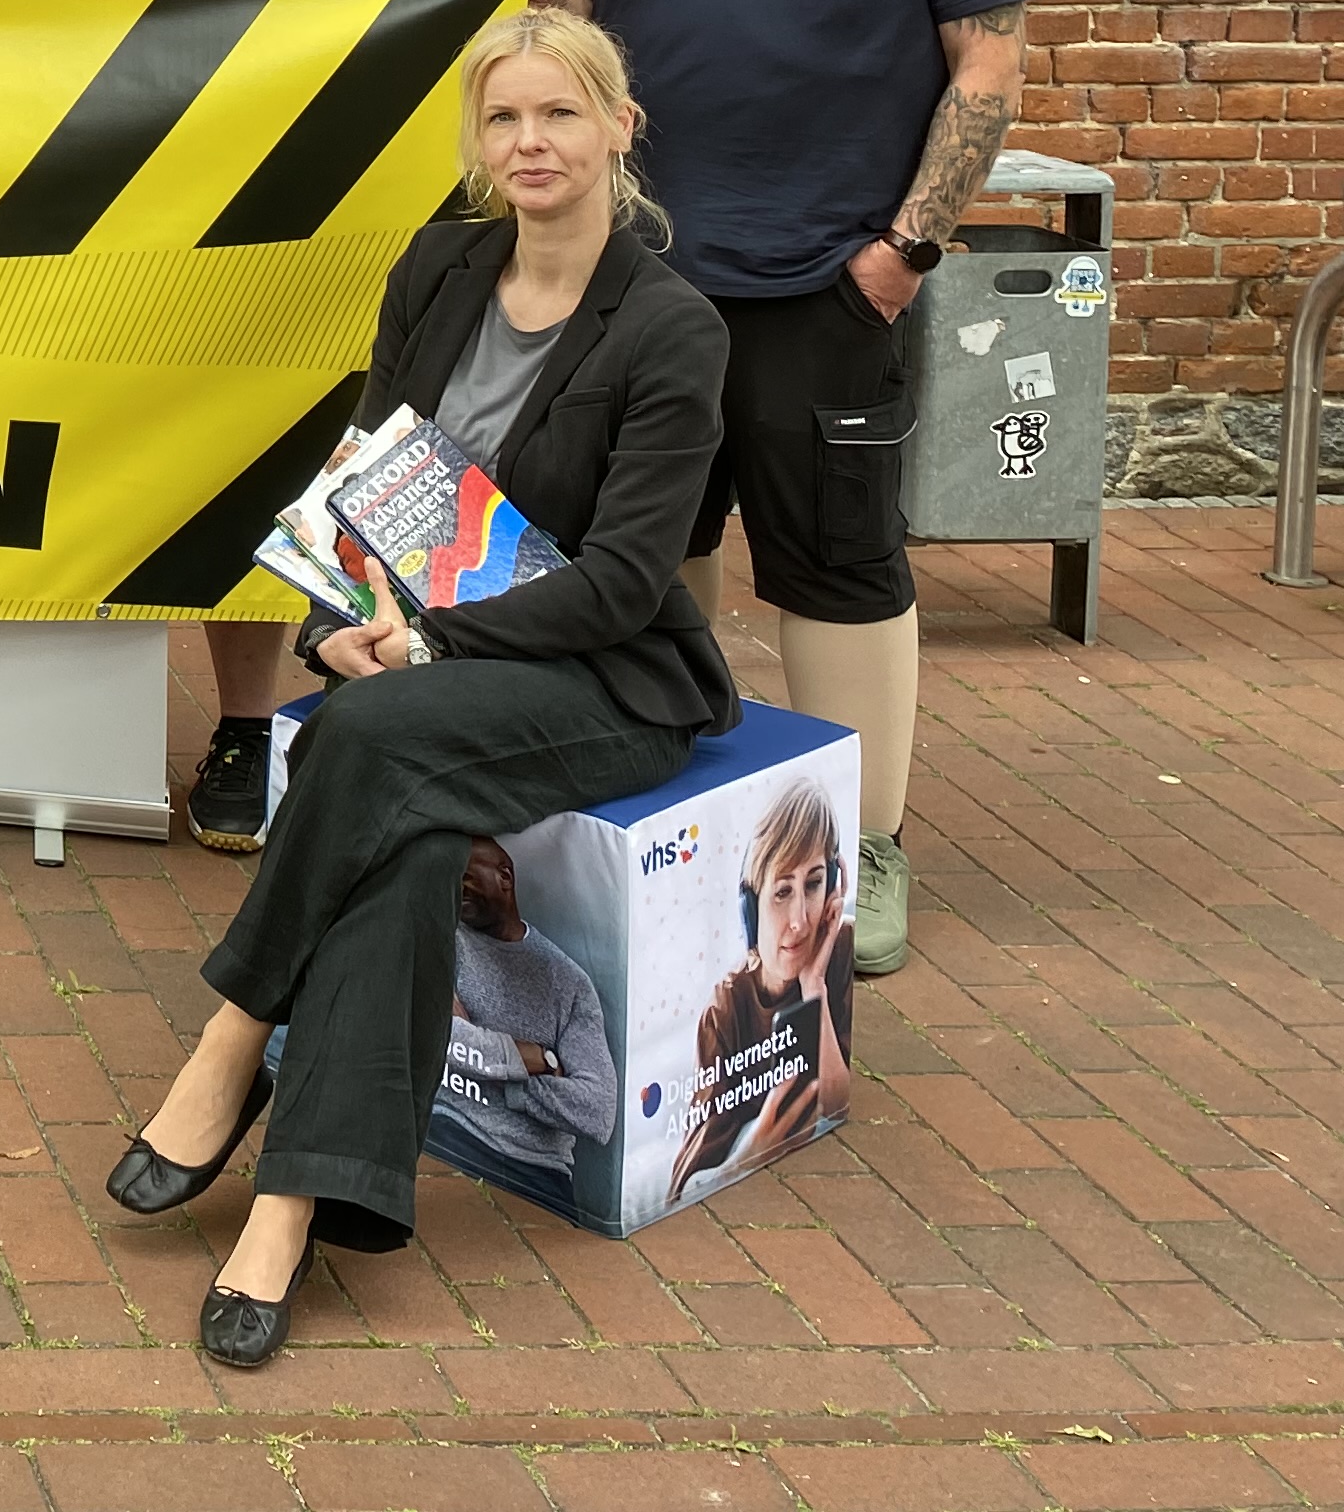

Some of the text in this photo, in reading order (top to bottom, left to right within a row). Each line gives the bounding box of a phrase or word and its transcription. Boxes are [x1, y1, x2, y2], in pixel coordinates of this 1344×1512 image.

[342, 440, 431, 518] OXFORD
[361, 457, 450, 538] Advanced
[372, 479, 457, 552] Learner's
[383, 510, 444, 563] DICTIONARY
[641, 840, 677, 876] vhs
[666, 1024, 797, 1104] Digital vernetzt.
[666, 1051, 809, 1139] Aktiv verbunden.
